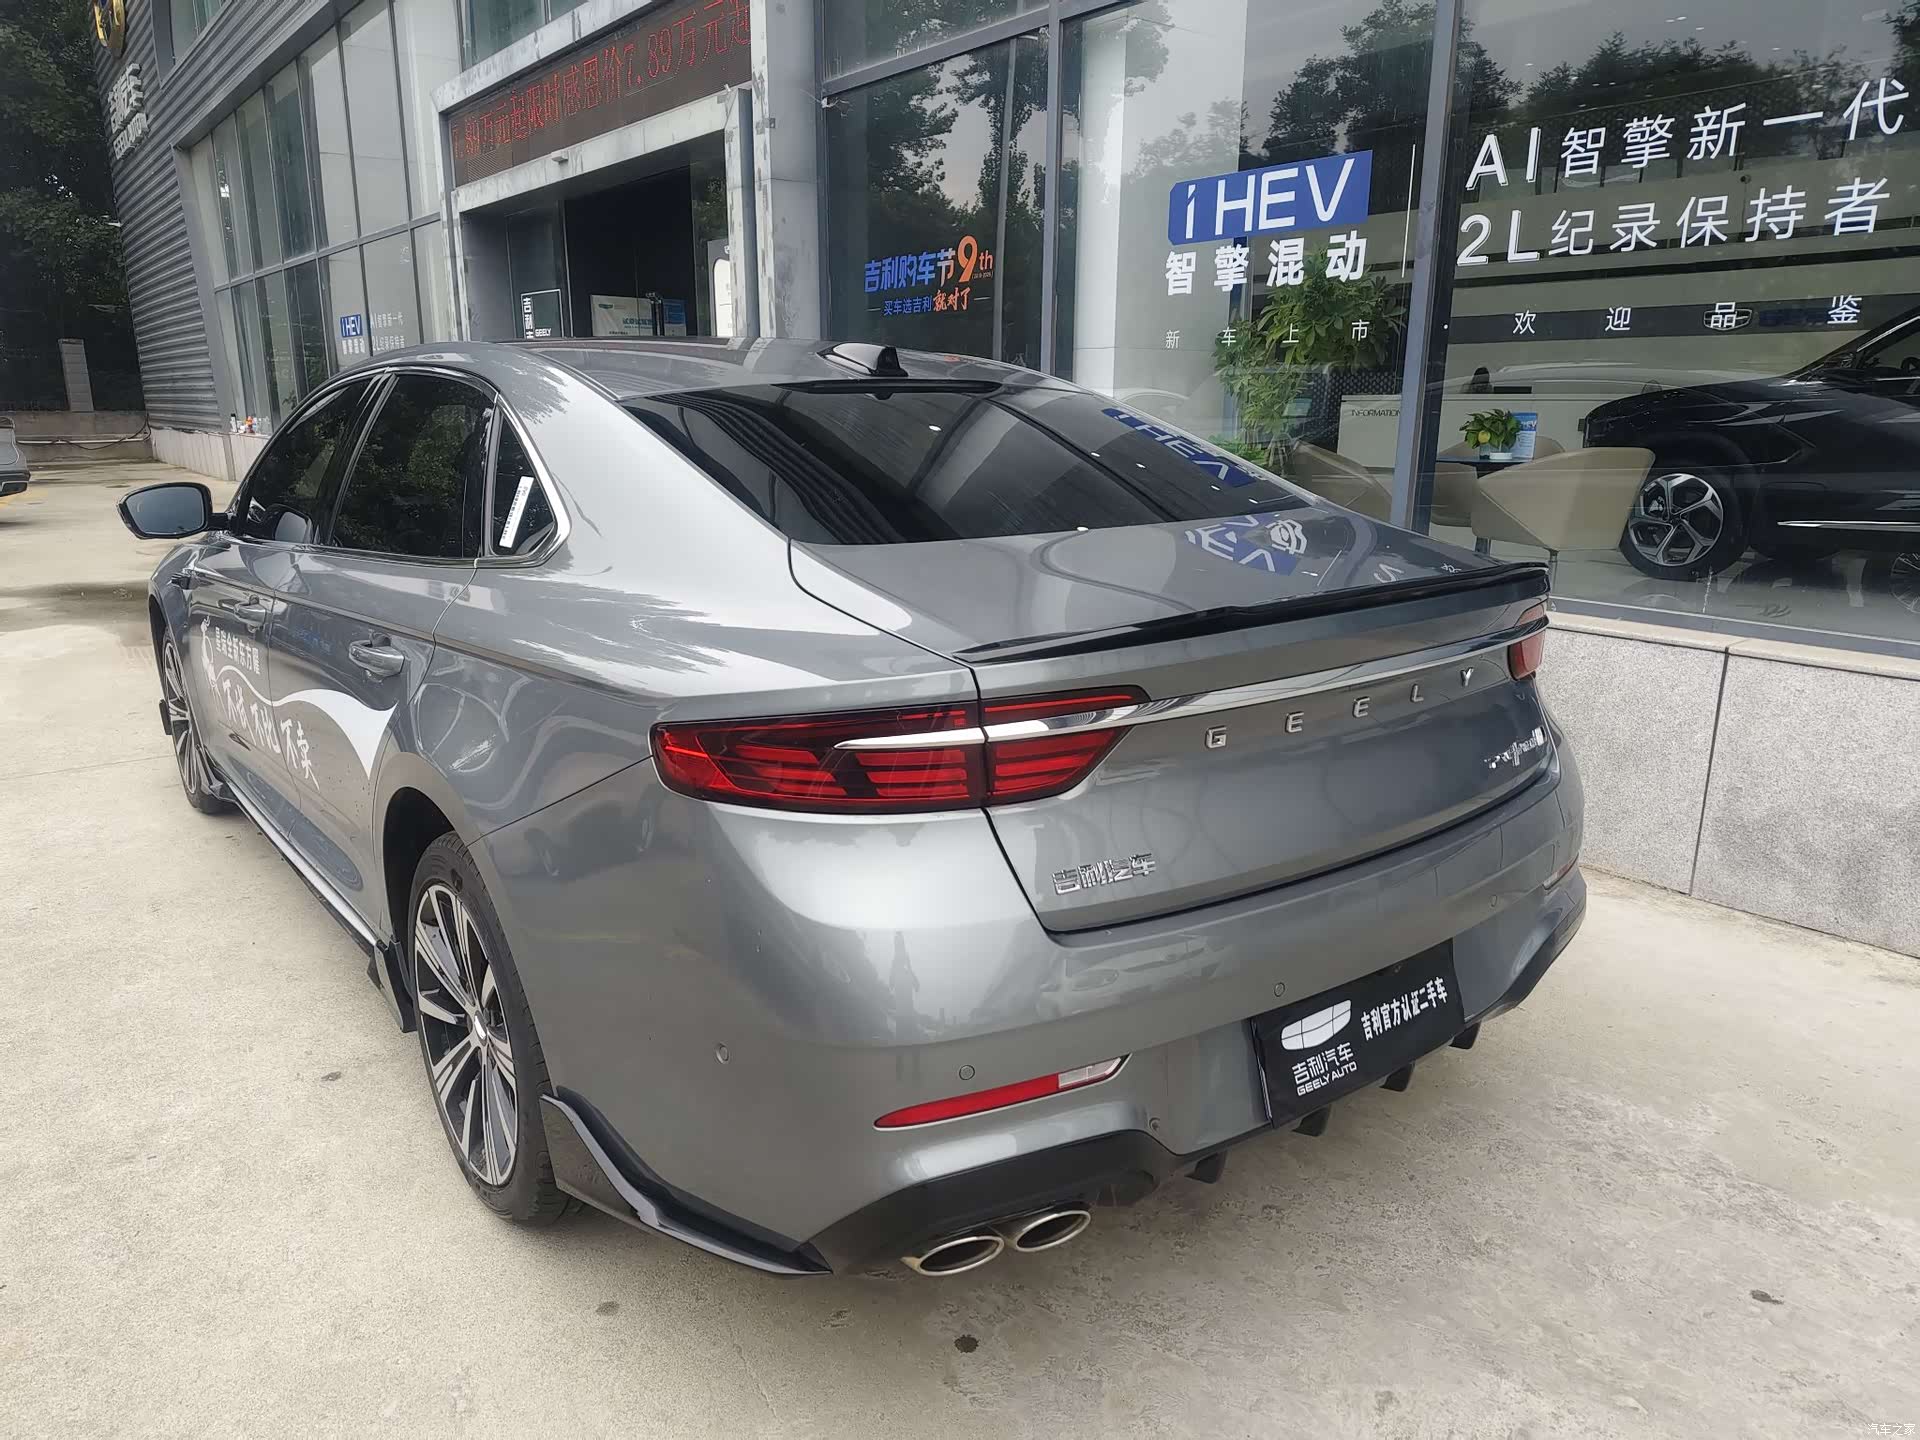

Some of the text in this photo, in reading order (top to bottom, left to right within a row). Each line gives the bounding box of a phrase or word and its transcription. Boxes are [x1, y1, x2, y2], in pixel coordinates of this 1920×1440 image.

[1465, 77, 1910, 191] AI智擎新一代
[1456, 176, 1891, 267] 2L纪录保持者
[1165, 230, 1368, 296] 智擎混动
[1165, 319, 1371, 349] 新车上市
[1511, 294, 1863, 335] 欢迎品鉴
[1205, 666, 1474, 750] GEELY
[1052, 852, 1157, 895] 吉利汽车
[1360, 976, 1449, 1041] 吉利官方认证二手车
[1291, 1041, 1355, 1085] 吉利汽车
[1296, 1060, 1358, 1097] GEELY AUTO
